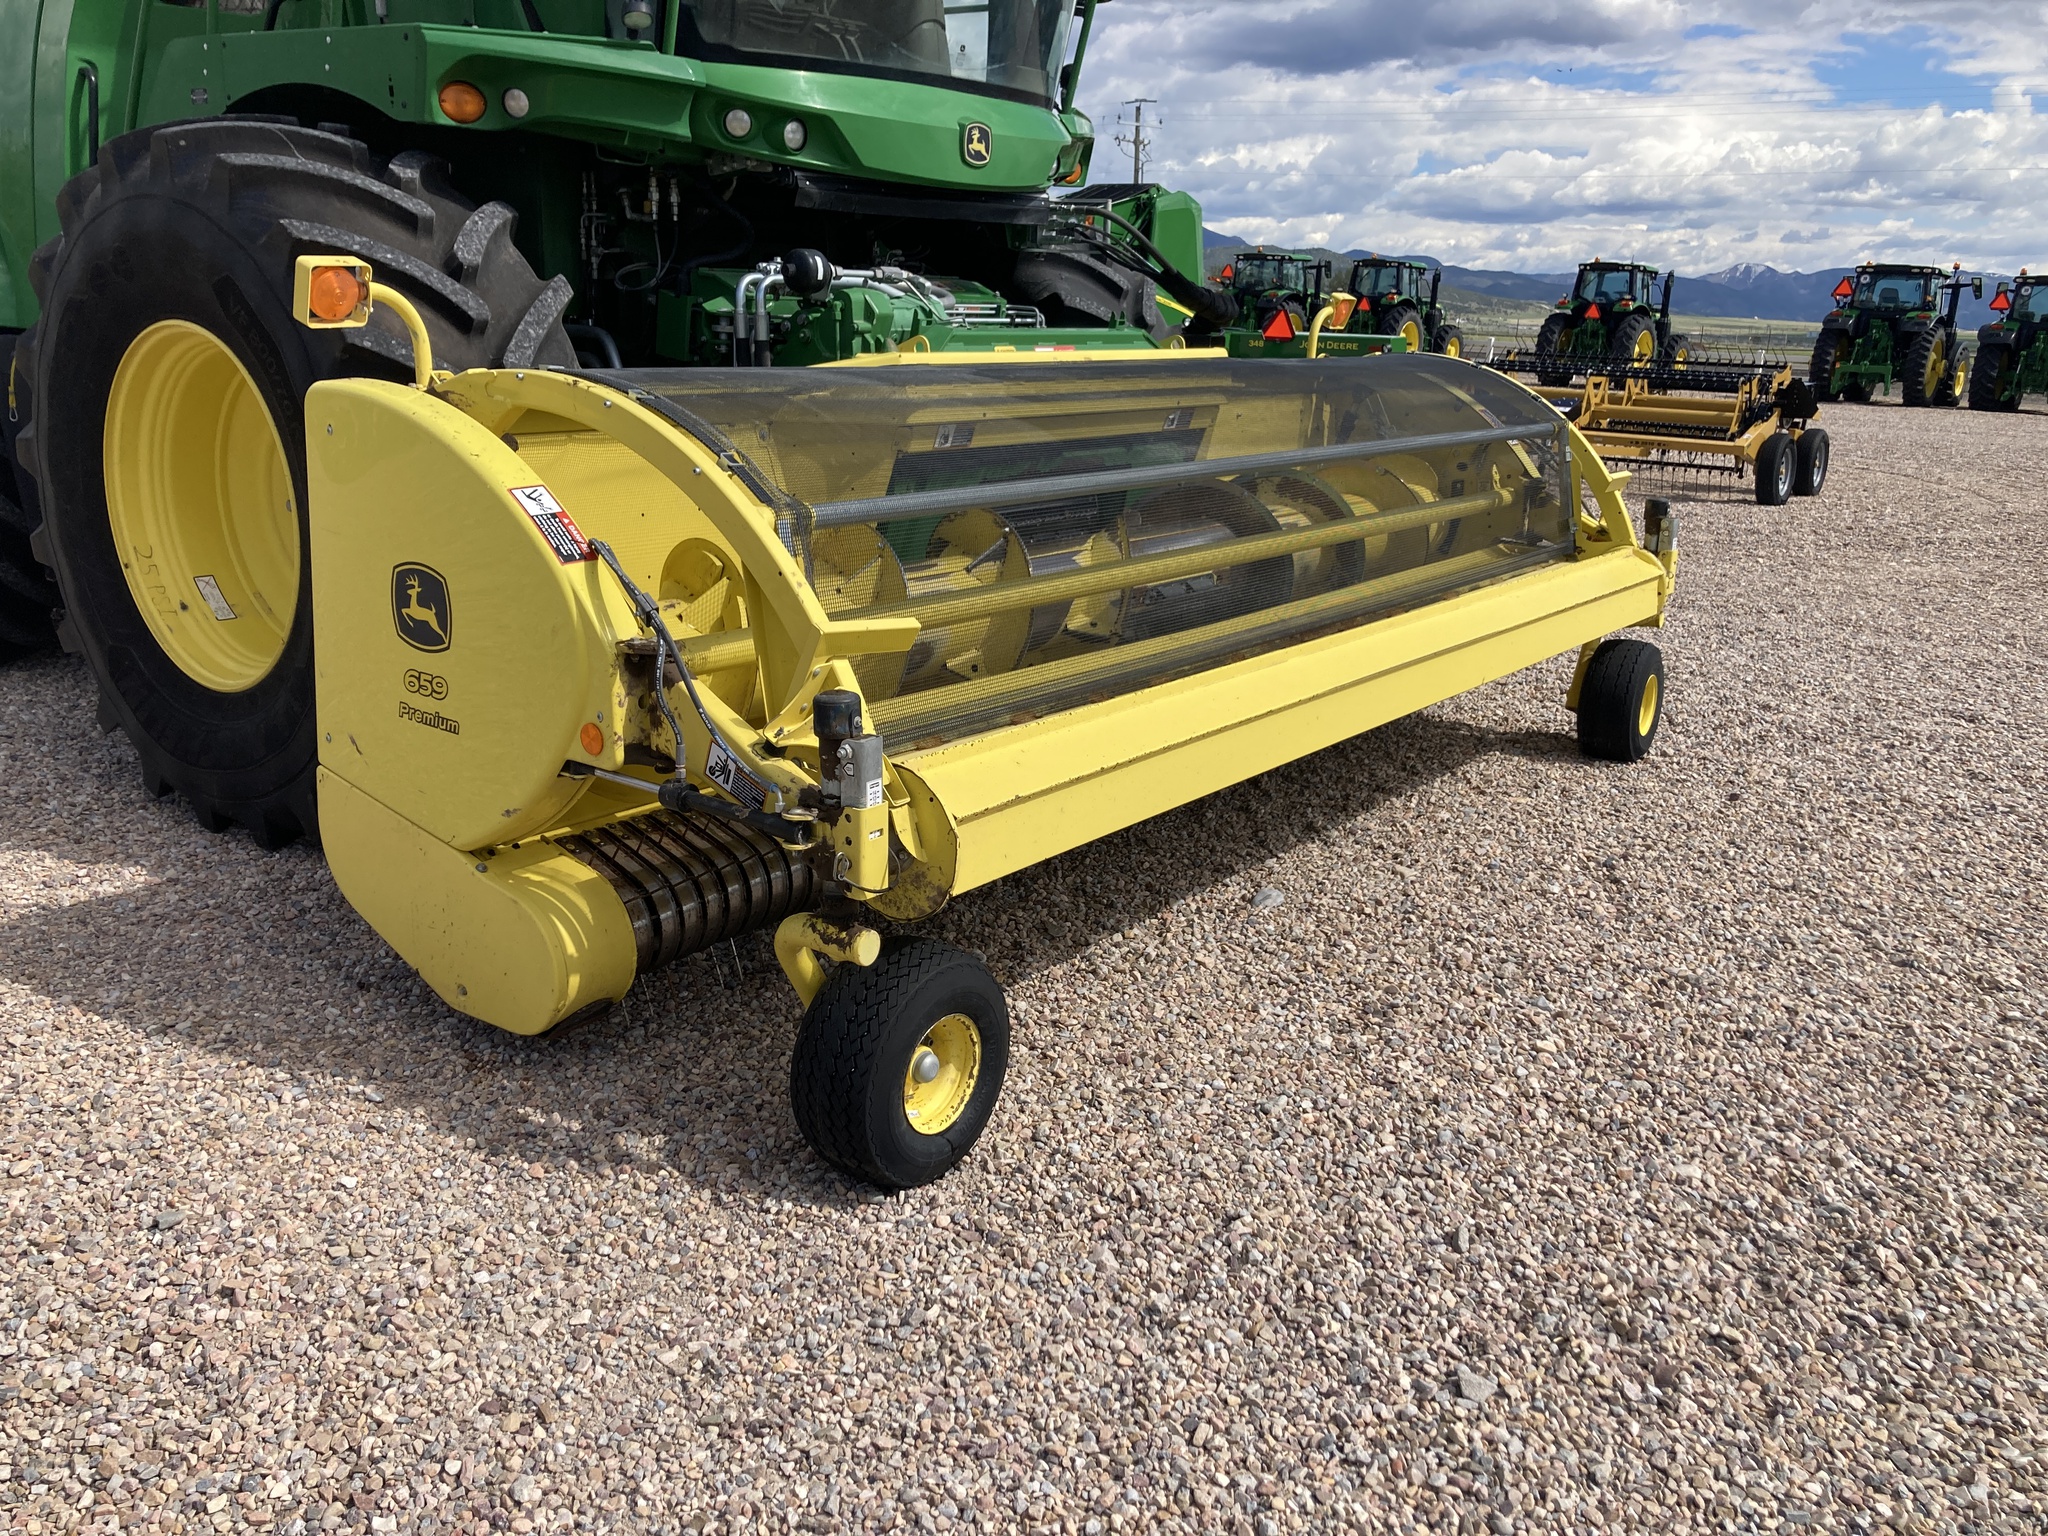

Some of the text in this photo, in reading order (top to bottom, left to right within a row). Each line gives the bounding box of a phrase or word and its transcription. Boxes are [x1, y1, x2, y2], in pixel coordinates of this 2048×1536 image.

[1248, 340, 1264, 348] 348
[1299, 340, 1359, 350] JON DEERE
[403, 668, 449, 701] 659
[398, 700, 460, 735] Premium
